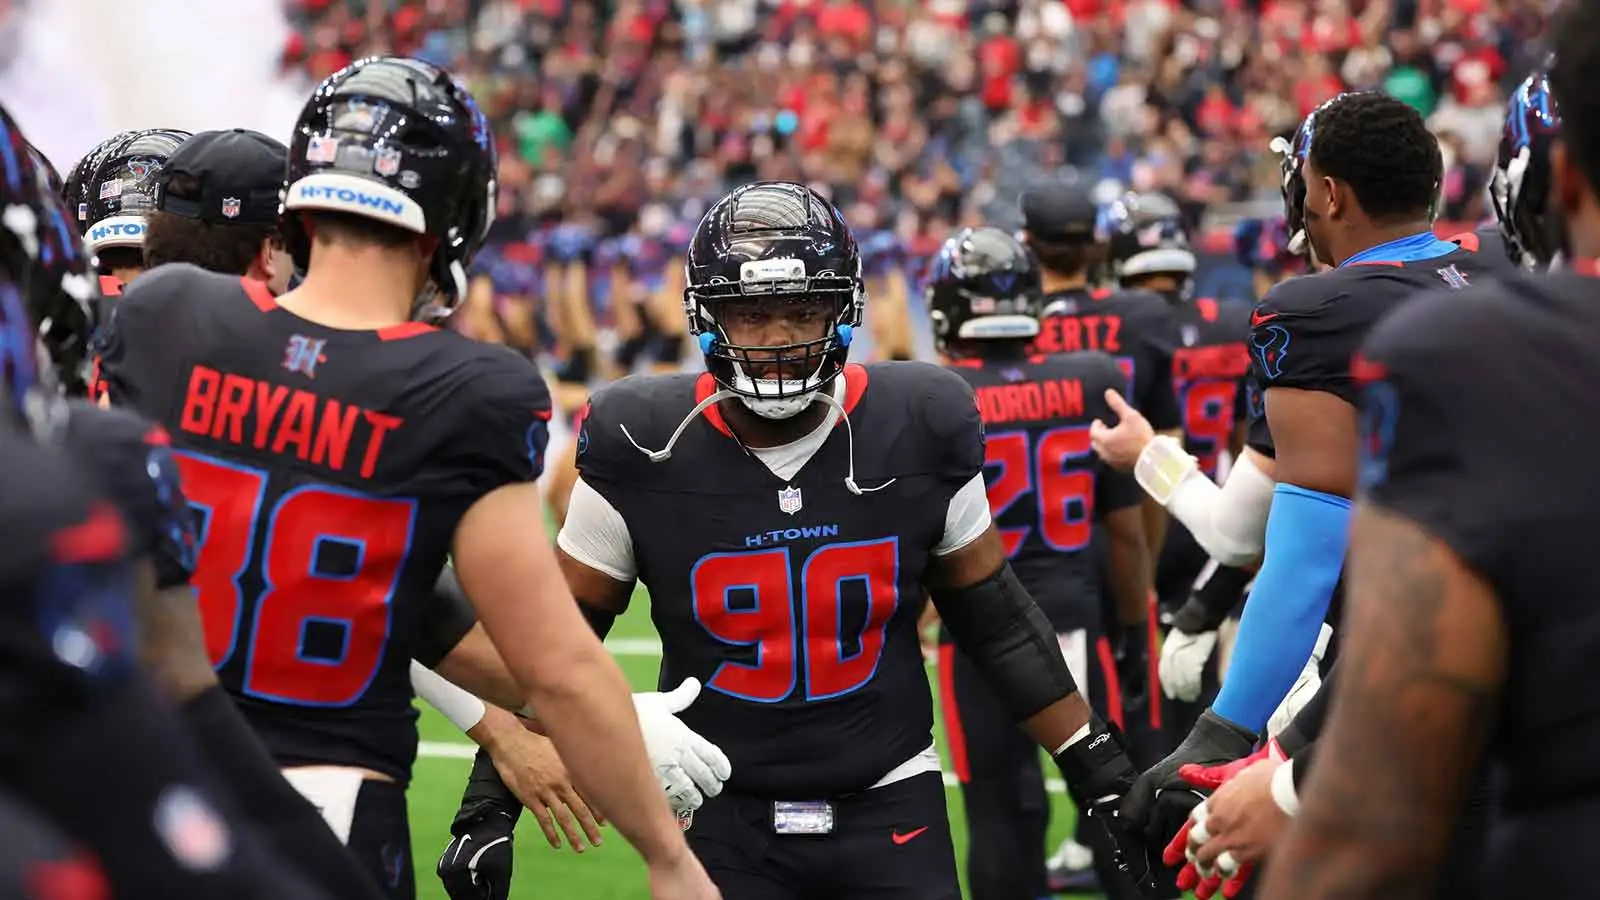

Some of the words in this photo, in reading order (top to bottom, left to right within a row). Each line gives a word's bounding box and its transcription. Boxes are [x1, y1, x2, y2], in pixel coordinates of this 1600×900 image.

[1025, 315, 1121, 352] ERTZ
[179, 364, 404, 479] BRYANT
[745, 524, 839, 548] H-TOWN
[984, 425, 1095, 561] 26
[690, 536, 899, 703] 90
